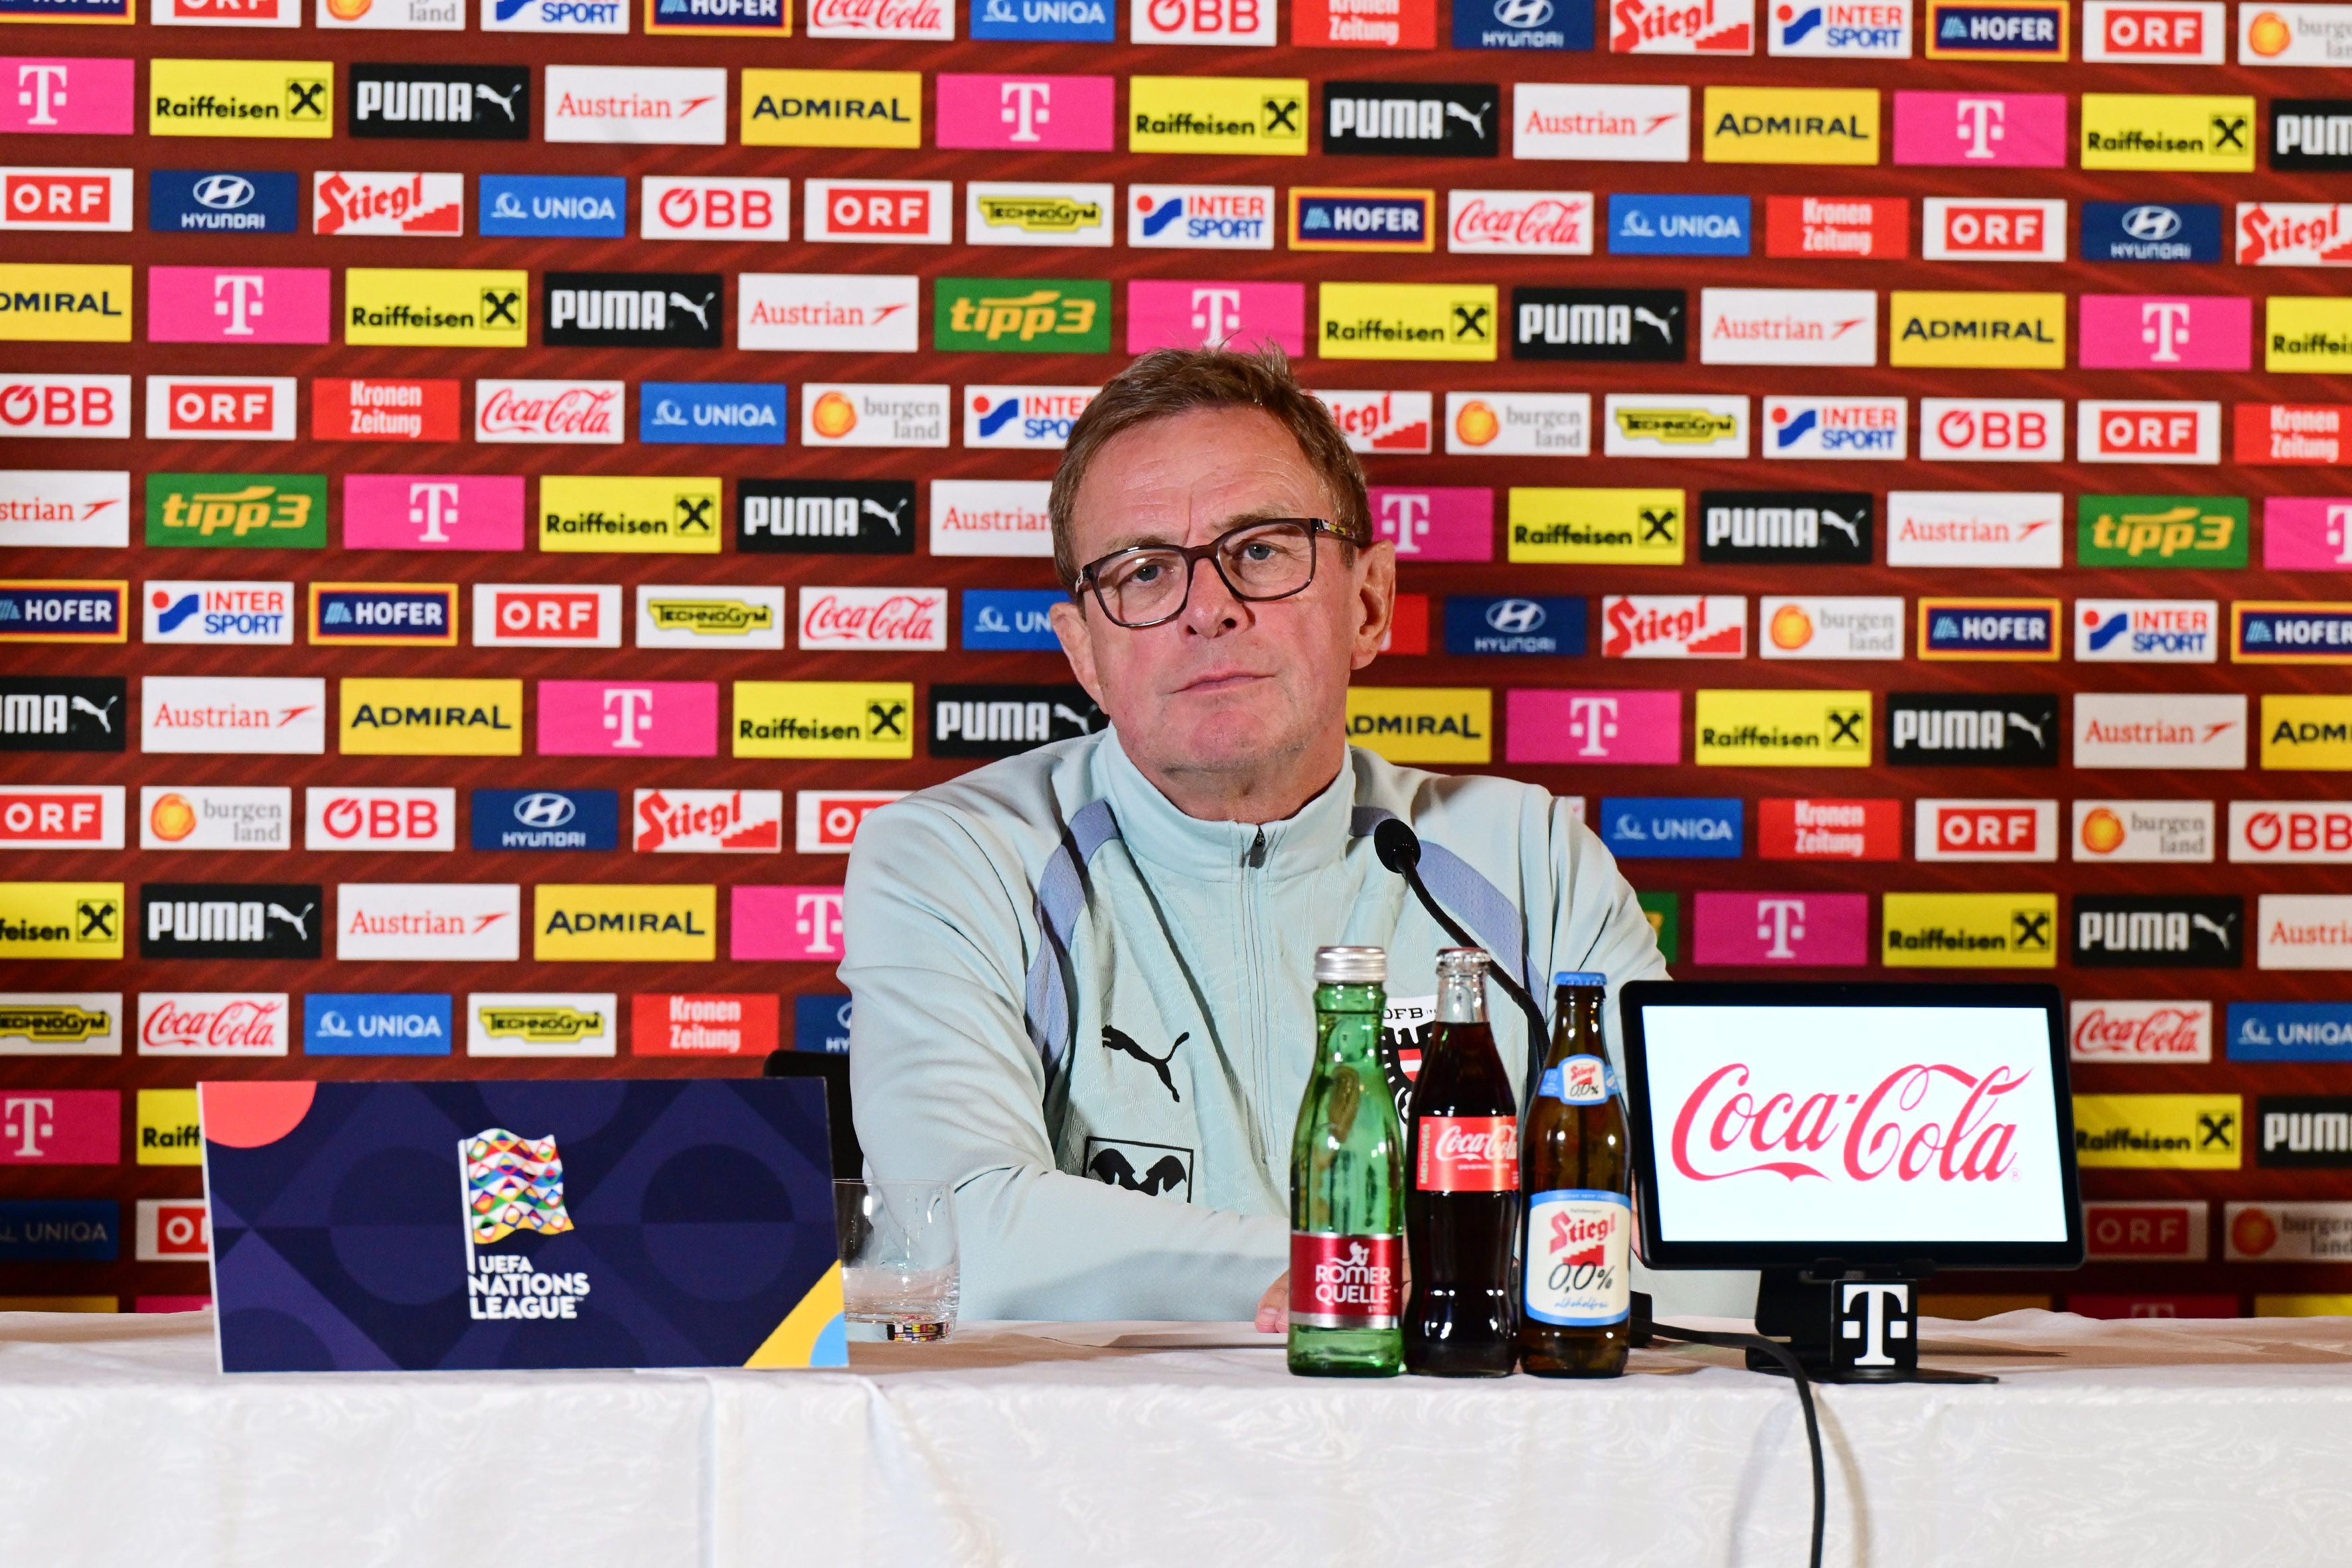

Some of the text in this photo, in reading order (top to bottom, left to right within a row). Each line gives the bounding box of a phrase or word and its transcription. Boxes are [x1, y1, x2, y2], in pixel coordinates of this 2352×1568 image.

[408, 0, 457, 23] land
[541, 1, 621, 25] SPORT
[691, 0, 777, 17] HOFER
[1023, 1, 1105, 24] UNIQA
[1828, 5, 1903, 27] INTER
[1329, 15, 1399, 46] Zeitung
[1482, 31, 1564, 48] HYUNDAI
[1611, 0, 1714, 54] Stiegl
[1827, 27, 1902, 48] SPORT
[1970, 17, 2053, 41] HOFER
[2111, 17, 2195, 46] ORF
[157, 96, 279, 118] Raiffeisen
[356, 81, 472, 122] PUMA
[557, 92, 672, 118] Austrian
[752, 95, 911, 122] ADMIRAL
[1137, 114, 1255, 134] Raiffeisen
[1330, 98, 1443, 139] PUMA
[1526, 110, 1636, 135] Austrian
[1715, 113, 1868, 139] ADMIRAL
[2088, 131, 2203, 151] Raiffeisen
[2276, 115, 2352, 155] PUM
[14, 184, 103, 213] ORF
[317, 172, 422, 236] Stiegl
[532, 196, 616, 220] UNIQA
[834, 196, 922, 226] ORF
[1189, 195, 1265, 216] INTER
[181, 213, 266, 229] HYUNDAI
[1334, 207, 1419, 232] HOFER
[1452, 199, 1583, 244] Coca-Cola
[1802, 198, 1873, 225] Kronen
[1187, 218, 1265, 240] SPORT
[1660, 215, 1741, 238] UNIQA
[1952, 215, 2037, 243] ORF
[2238, 202, 2339, 266] Stiegl
[1803, 226, 1873, 256] Zeitung
[2110, 243, 2191, 260] HYUNDAI
[353, 305, 474, 327] Raiffeisen
[551, 289, 666, 331] PUMA
[751, 300, 864, 326] Austrian
[951, 291, 1096, 341] tipp3
[1326, 320, 1444, 341] Raiffeisen
[1519, 303, 1631, 345] PUMA
[1714, 315, 1823, 340] Austrian
[1902, 317, 2054, 343] ADMIRAL
[2273, 335, 2347, 353] Raiffei
[350, 380, 422, 407] Kronen
[177, 393, 266, 422] ORF
[479, 388, 614, 434] Coca-Cola
[693, 404, 776, 427] UNIQA
[864, 396, 941, 420] burgen
[1333, 392, 1391, 435] iegl
[1506, 405, 1581, 428] burgen
[1823, 407, 1897, 428] INTER
[2270, 406, 2339, 433] Kronen
[351, 408, 422, 438] Zeitung
[894, 416, 941, 439] land
[2106, 418, 2191, 446] ORF
[1535, 429, 1581, 447] land
[1822, 429, 1897, 451] SPORT
[2270, 433, 2339, 463] Zeitung
[0, 497, 74, 522] strian
[163, 486, 311, 536] tipp3
[744, 496, 858, 536] PUMA
[546, 512, 668, 534] Raiffeisen
[1514, 524, 1632, 545] Raiffeisen
[1707, 507, 1818, 548] PUMA
[1901, 518, 2009, 542] Austrian
[2094, 507, 2234, 557] tipp3
[25, 599, 112, 622] HOFER
[206, 590, 284, 612] INTER
[355, 601, 442, 625] HOFER
[204, 612, 285, 636] SPORT
[503, 601, 591, 629] ORF
[803, 595, 936, 641] Coca-Cola
[1604, 596, 1706, 658] Stiegl
[1820, 609, 1895, 631] burgen
[2134, 610, 2208, 631] INTER
[1962, 617, 2045, 641] HOFER
[1475, 638, 1555, 652] HYUNDAI
[1849, 633, 1894, 651] land
[2134, 633, 2207, 652] SPORT
[153, 703, 270, 728] Austrian
[351, 704, 512, 730] ADMIRAL
[937, 701, 1053, 740] PUMA
[1346, 714, 1482, 738] DMIRAL
[740, 718, 860, 740] Raiffeisen
[1703, 727, 1819, 747] Raiffeisen
[1893, 710, 2004, 749] PUMA
[2085, 720, 2195, 744] Austrian
[5, 803, 95, 831] ORF
[202, 798, 282, 823] burgen
[636, 789, 740, 852] Stiegl
[1795, 801, 1865, 826] Kronen
[2131, 812, 2205, 834] burgen
[233, 820, 281, 842] land
[502, 831, 586, 848] HYUNDAI
[1654, 820, 1732, 839] UNIQA
[1796, 828, 1864, 856] Zeitung
[1945, 817, 2026, 843] ORF
[2160, 834, 2205, 854] land
[148, 902, 264, 941] PUMA
[350, 909, 465, 935] Austrian
[546, 910, 705, 935] ADMIRAL
[2080, 912, 2189, 950] PUMA
[2270, 921, 2352, 945] Austri
[1887, 927, 2006, 951] Raiffeisen
[669, 996, 742, 1022] Kronen
[0, 1011, 107, 1036] ECHNOGYM
[141, 1000, 279, 1048] Coca-Cola
[358, 1014, 442, 1038] UNIQA
[2075, 1008, 2201, 1053] Coca-Cola
[2278, 1023, 2352, 1044] UNIQA
[670, 1024, 741, 1053] Zeitung
[1671, 1062, 2035, 1183] Coca-Cola
[2264, 1113, 2352, 1150] PUM
[25, 1223, 109, 1243] UNIQA
[1549, 1210, 1616, 1254] Stiegl
[2096, 1217, 2181, 1245] ORF
[479, 1255, 534, 1275] UEFA
[1548, 1261, 1615, 1293] 0,0%
[467, 1272, 591, 1296] NATIONS
[1315, 1283, 1391, 1306] QUELLE
[469, 1296, 578, 1320] LEAGUE
